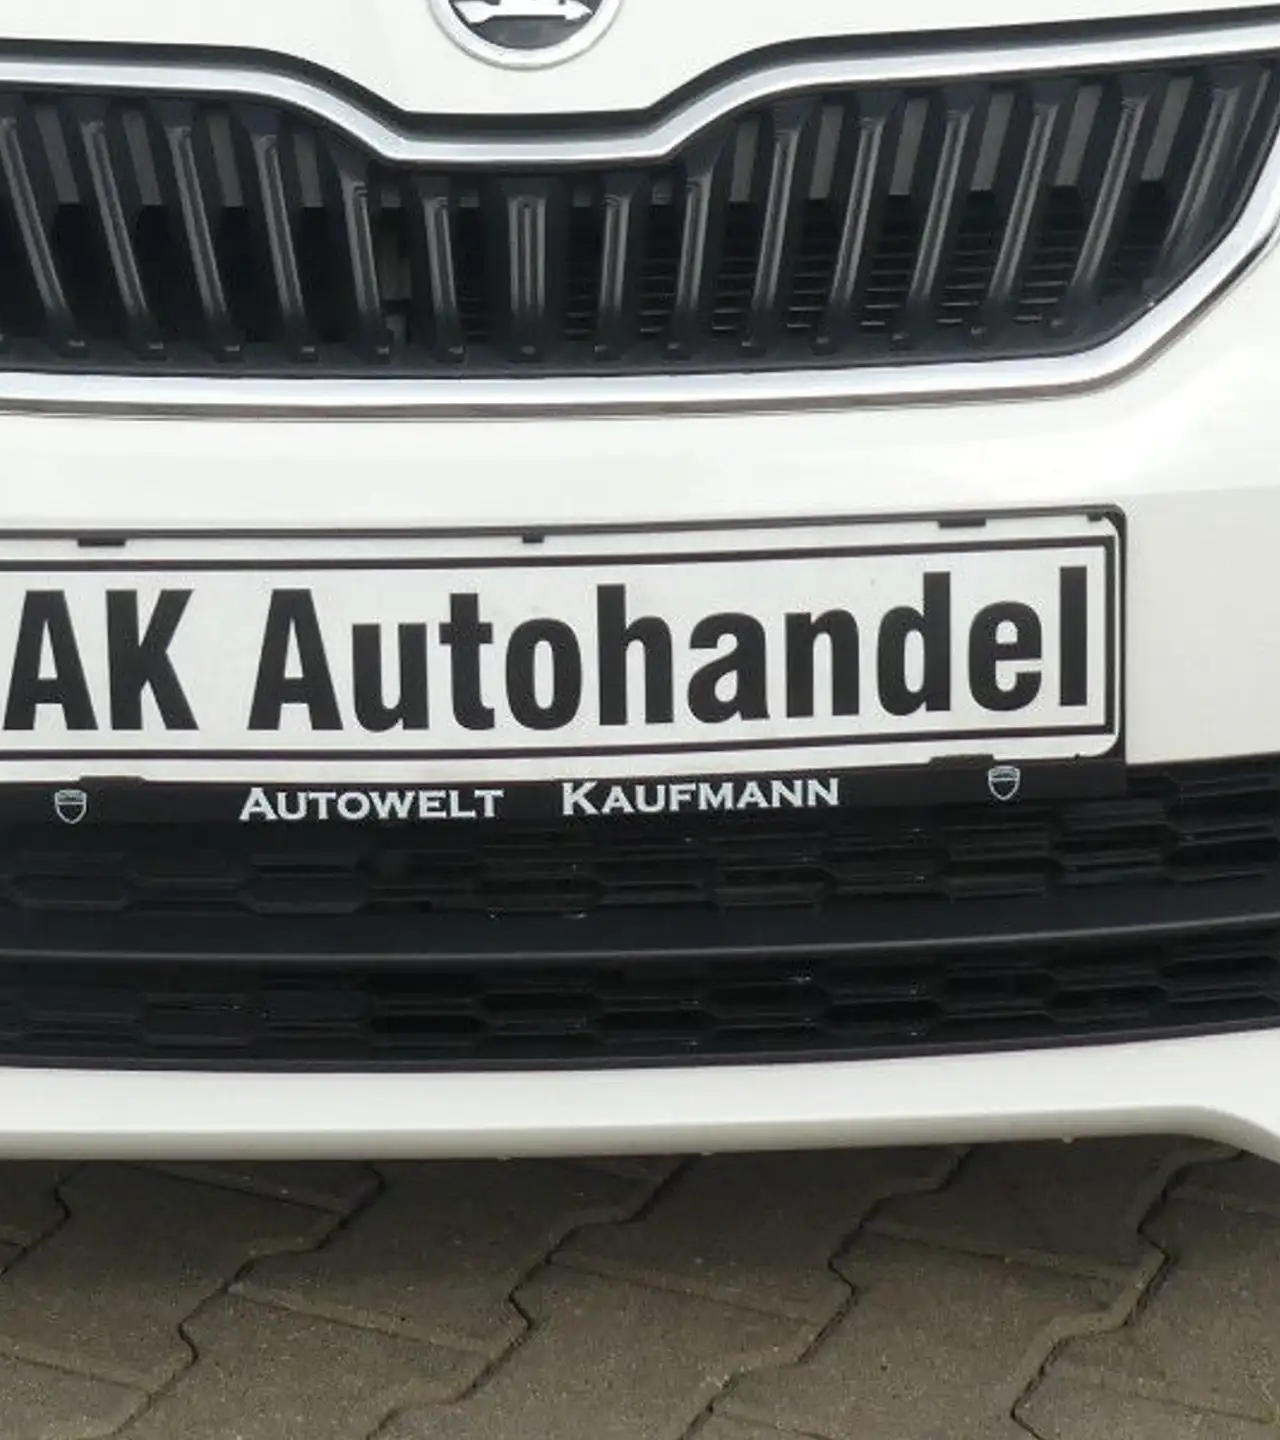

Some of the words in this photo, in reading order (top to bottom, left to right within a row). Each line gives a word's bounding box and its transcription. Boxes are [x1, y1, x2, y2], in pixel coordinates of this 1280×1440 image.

[2, 588, 199, 731] AK
[247, 566, 1088, 733] Autohandel
[239, 786, 505, 821] AUTOWELT
[561, 777, 839, 816] KAUFMANN
